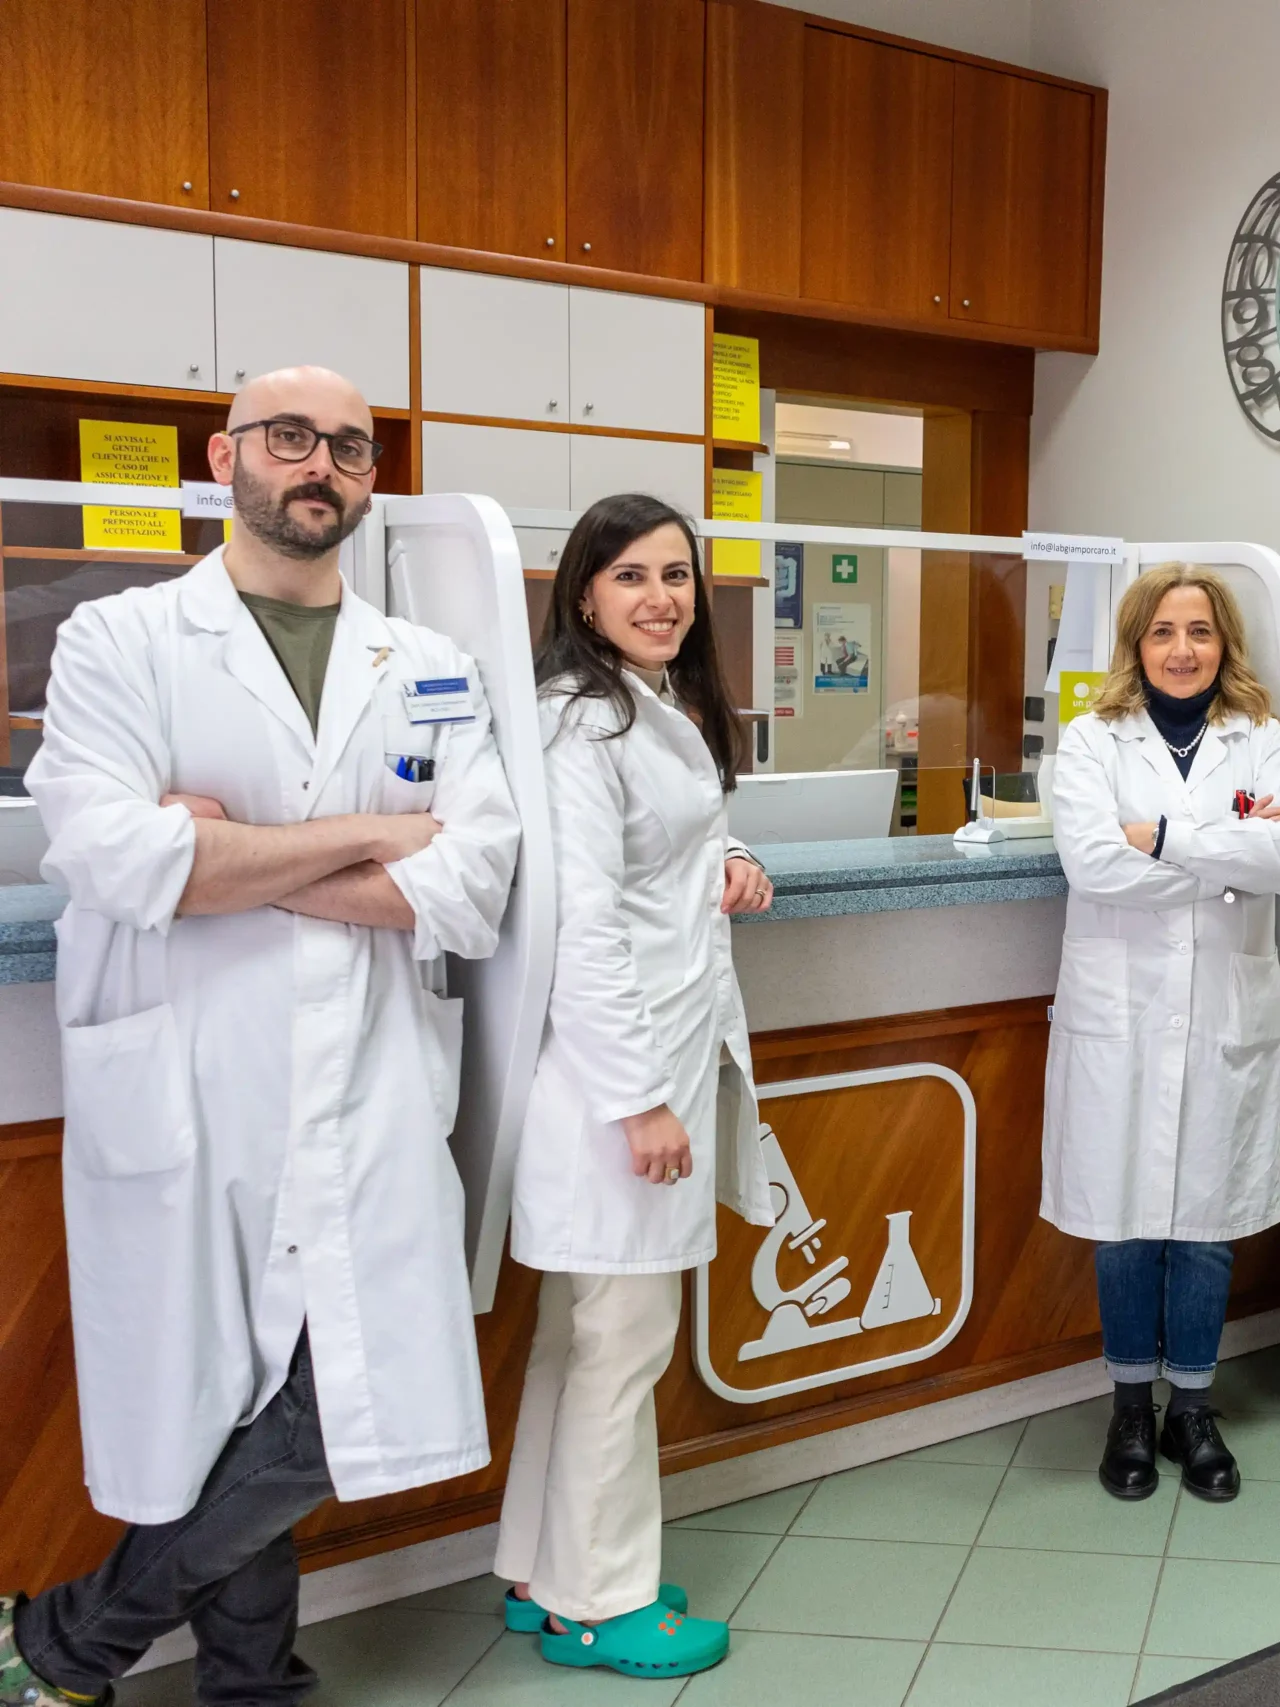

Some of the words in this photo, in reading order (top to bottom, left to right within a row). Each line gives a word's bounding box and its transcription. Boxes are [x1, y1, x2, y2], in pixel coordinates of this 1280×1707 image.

[104, 434, 112, 442] SI
[113, 435, 143, 444] AVVISA
[145, 436, 157, 444] LA
[112, 444, 149, 453] GENTILE
[91, 452, 140, 462] CLIENTELA
[141, 455, 159, 463] CHE
[114, 463, 138, 471] CASO
[94, 471, 162, 481] ASSICURAZIONE
[109, 509, 159, 518] PERSONALE
[102, 518, 146, 527] PREPOSTO
[103, 528, 168, 537] ACCETTAZIONE
[1030, 541, 1117, 556] info@labgiamporcaro.it
